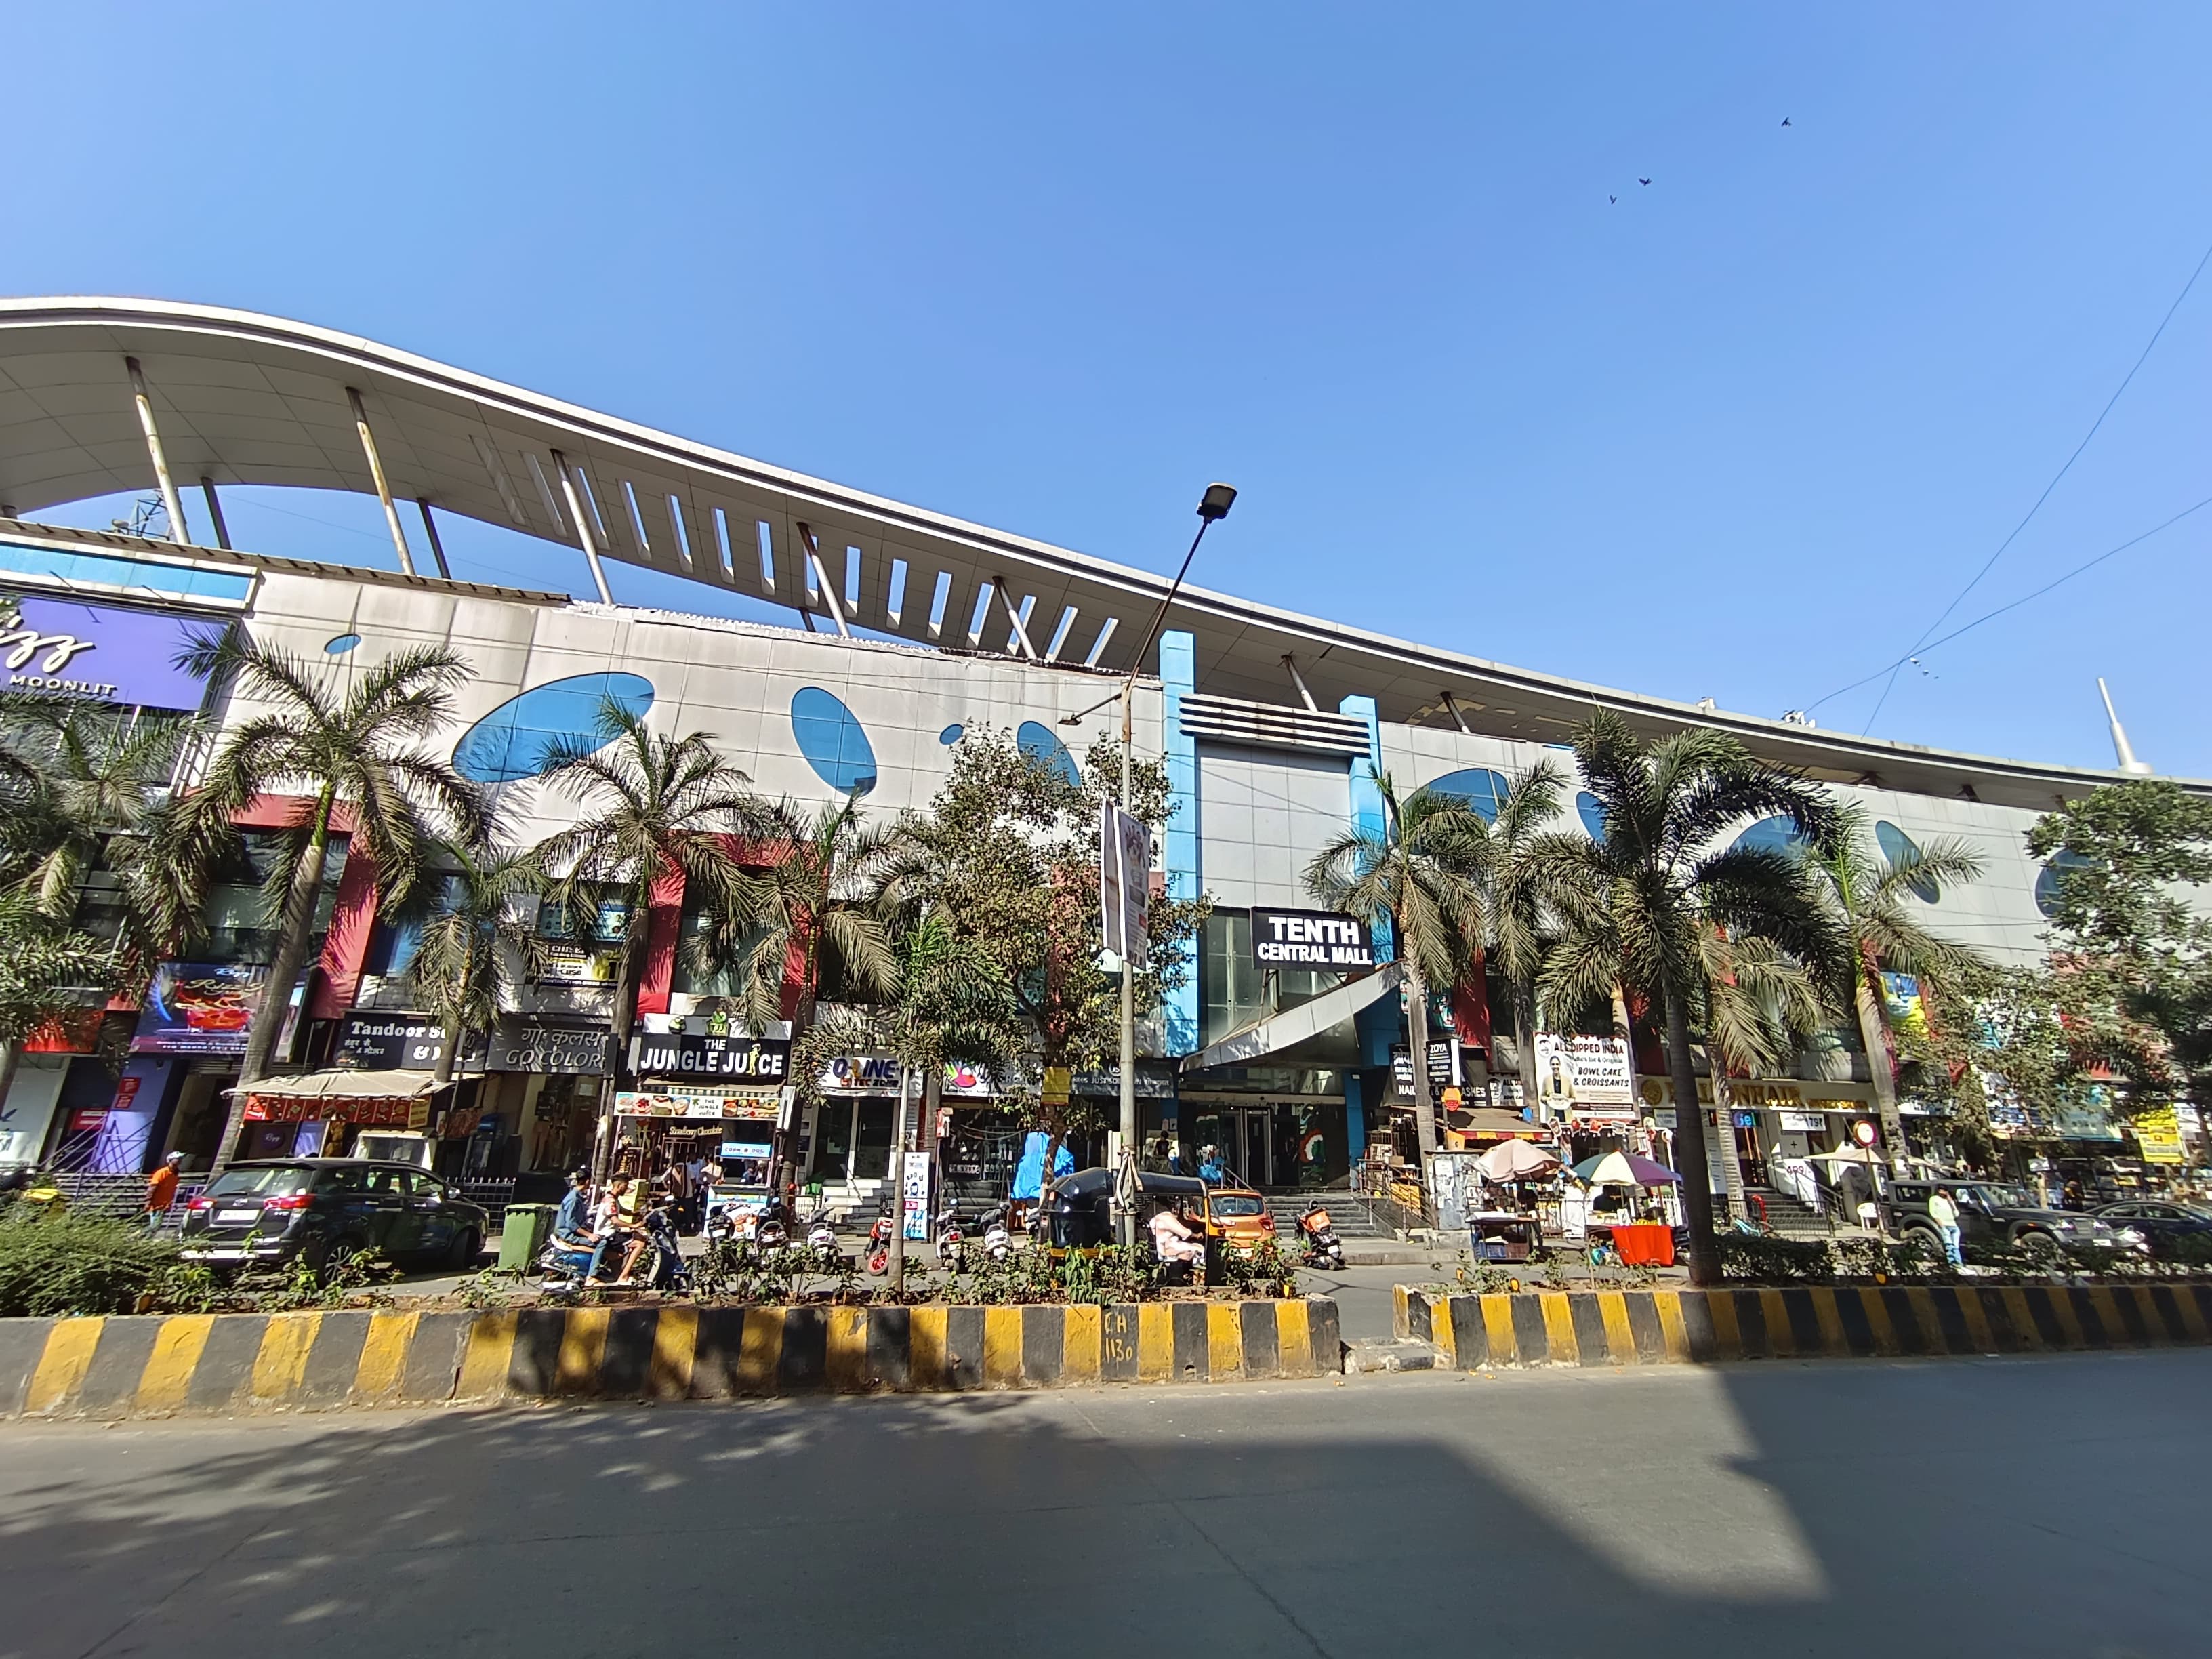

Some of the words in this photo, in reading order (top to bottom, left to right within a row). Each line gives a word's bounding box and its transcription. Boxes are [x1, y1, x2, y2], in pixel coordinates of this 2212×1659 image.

[9, 674, 117, 695] MOONLIT
[1268, 916, 1359, 945] TENTH
[1258, 943, 1329, 963] CENTRAL
[1332, 946, 1372, 965] MALL
[352, 1021, 425, 1038] Tandoor
[413, 1046, 430, 1060] &
[704, 1039, 726, 1050] THE
[1429, 1044, 1448, 1053] ZOYA
[1571, 1044, 1600, 1054] DIPPED
[506, 1050, 535, 1068] GO
[640, 1048, 719, 1072] JUNGLE
[1578, 1067, 1600, 1076] BOWL
[1573, 1078, 1579, 1086] &
[1581, 1078, 1629, 1087] CROISSANTS
[1105, 1338, 1133, 1364] 1130
